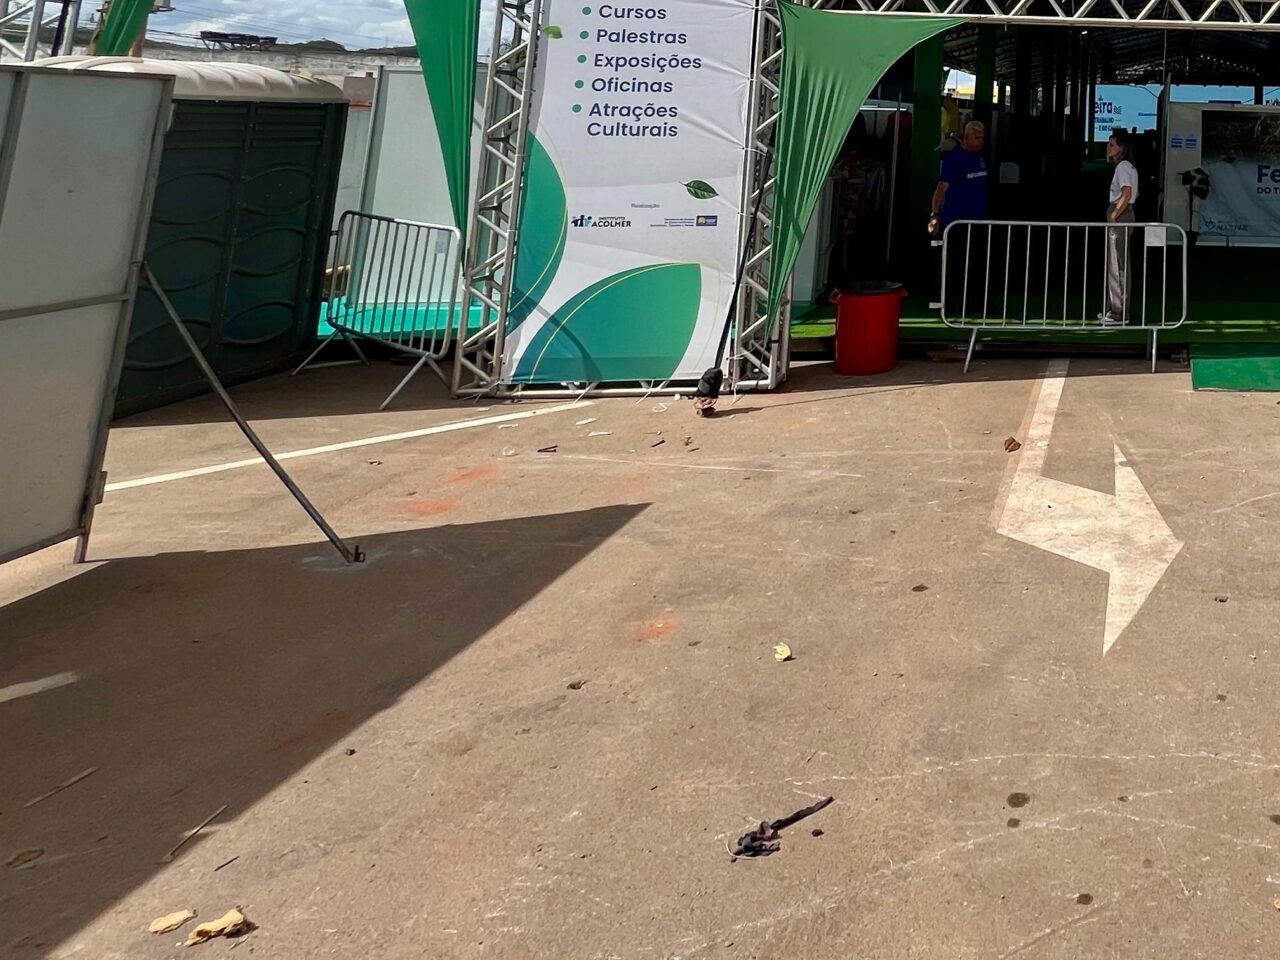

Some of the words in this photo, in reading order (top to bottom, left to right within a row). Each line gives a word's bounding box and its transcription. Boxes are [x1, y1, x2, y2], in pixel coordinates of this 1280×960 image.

[598, 4, 667, 20] Cursos
[596, 28, 688, 44] Palestras
[593, 53, 702, 73] Exposições
[591, 77, 674, 93] Oficinas
[588, 102, 679, 121] Atrações
[587, 122, 679, 137] Culturais
[591, 220, 632, 228] ACOLHER
